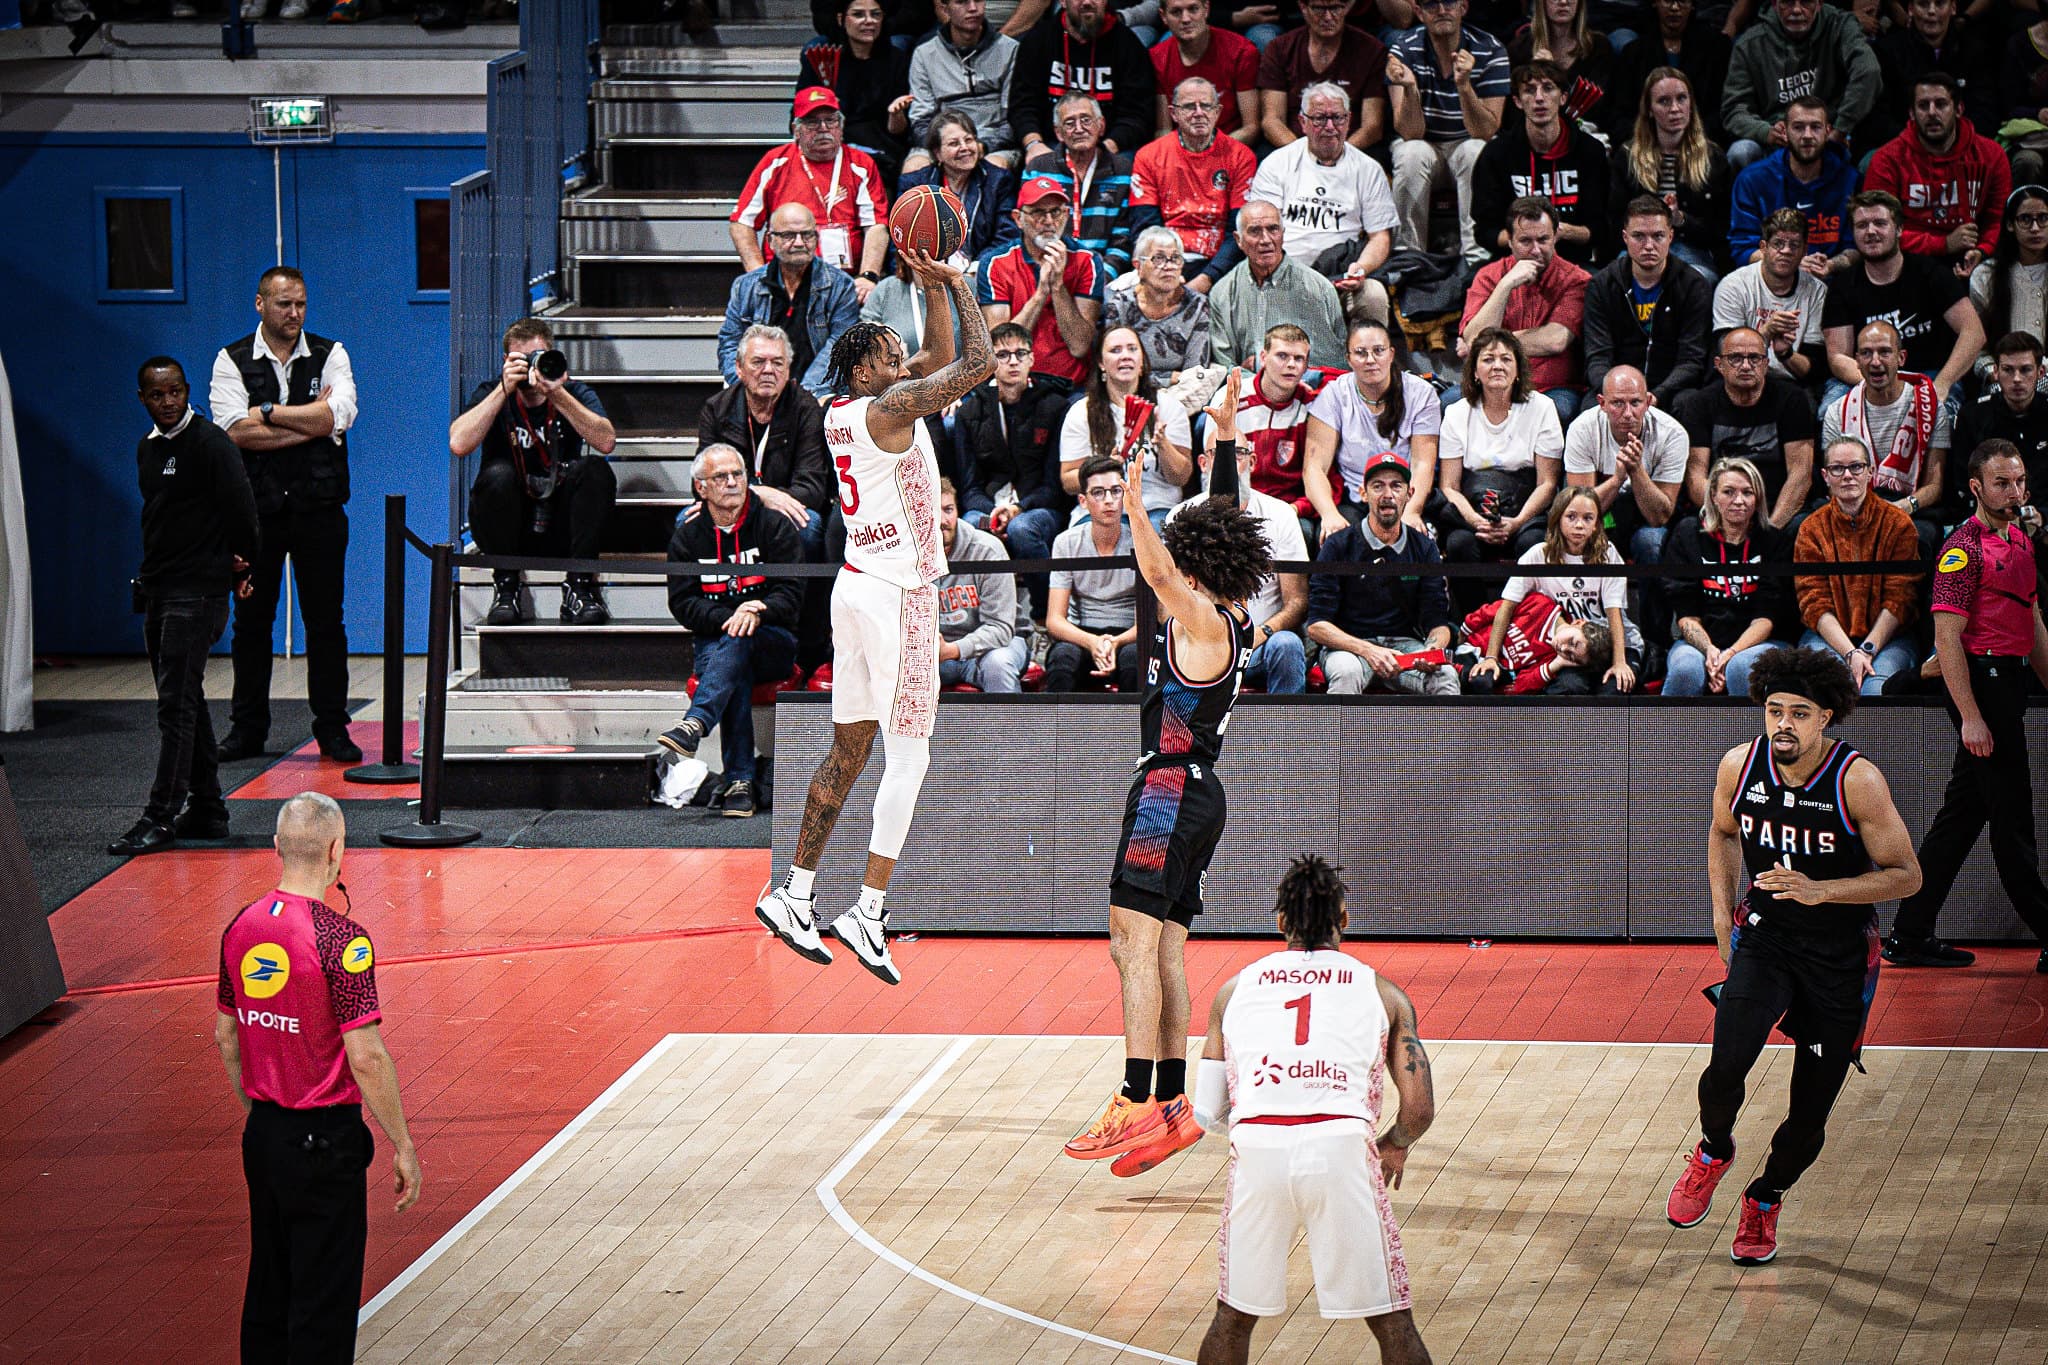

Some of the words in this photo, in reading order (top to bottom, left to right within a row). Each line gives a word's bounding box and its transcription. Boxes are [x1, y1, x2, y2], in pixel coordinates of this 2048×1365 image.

[1777, 67, 1818, 91] TEDDY
[1779, 83, 1815, 104] SMIT
[1286, 203, 1347, 231] NANCY
[836, 455, 860, 516] 3
[853, 522, 899, 548] dalkia
[1740, 813, 1836, 856] PARIS
[1258, 968, 1332, 985] MASON
[1337, 969, 1353, 984] III
[1284, 992, 1312, 1046] 1
[1287, 1059, 1348, 1083] dalkia
